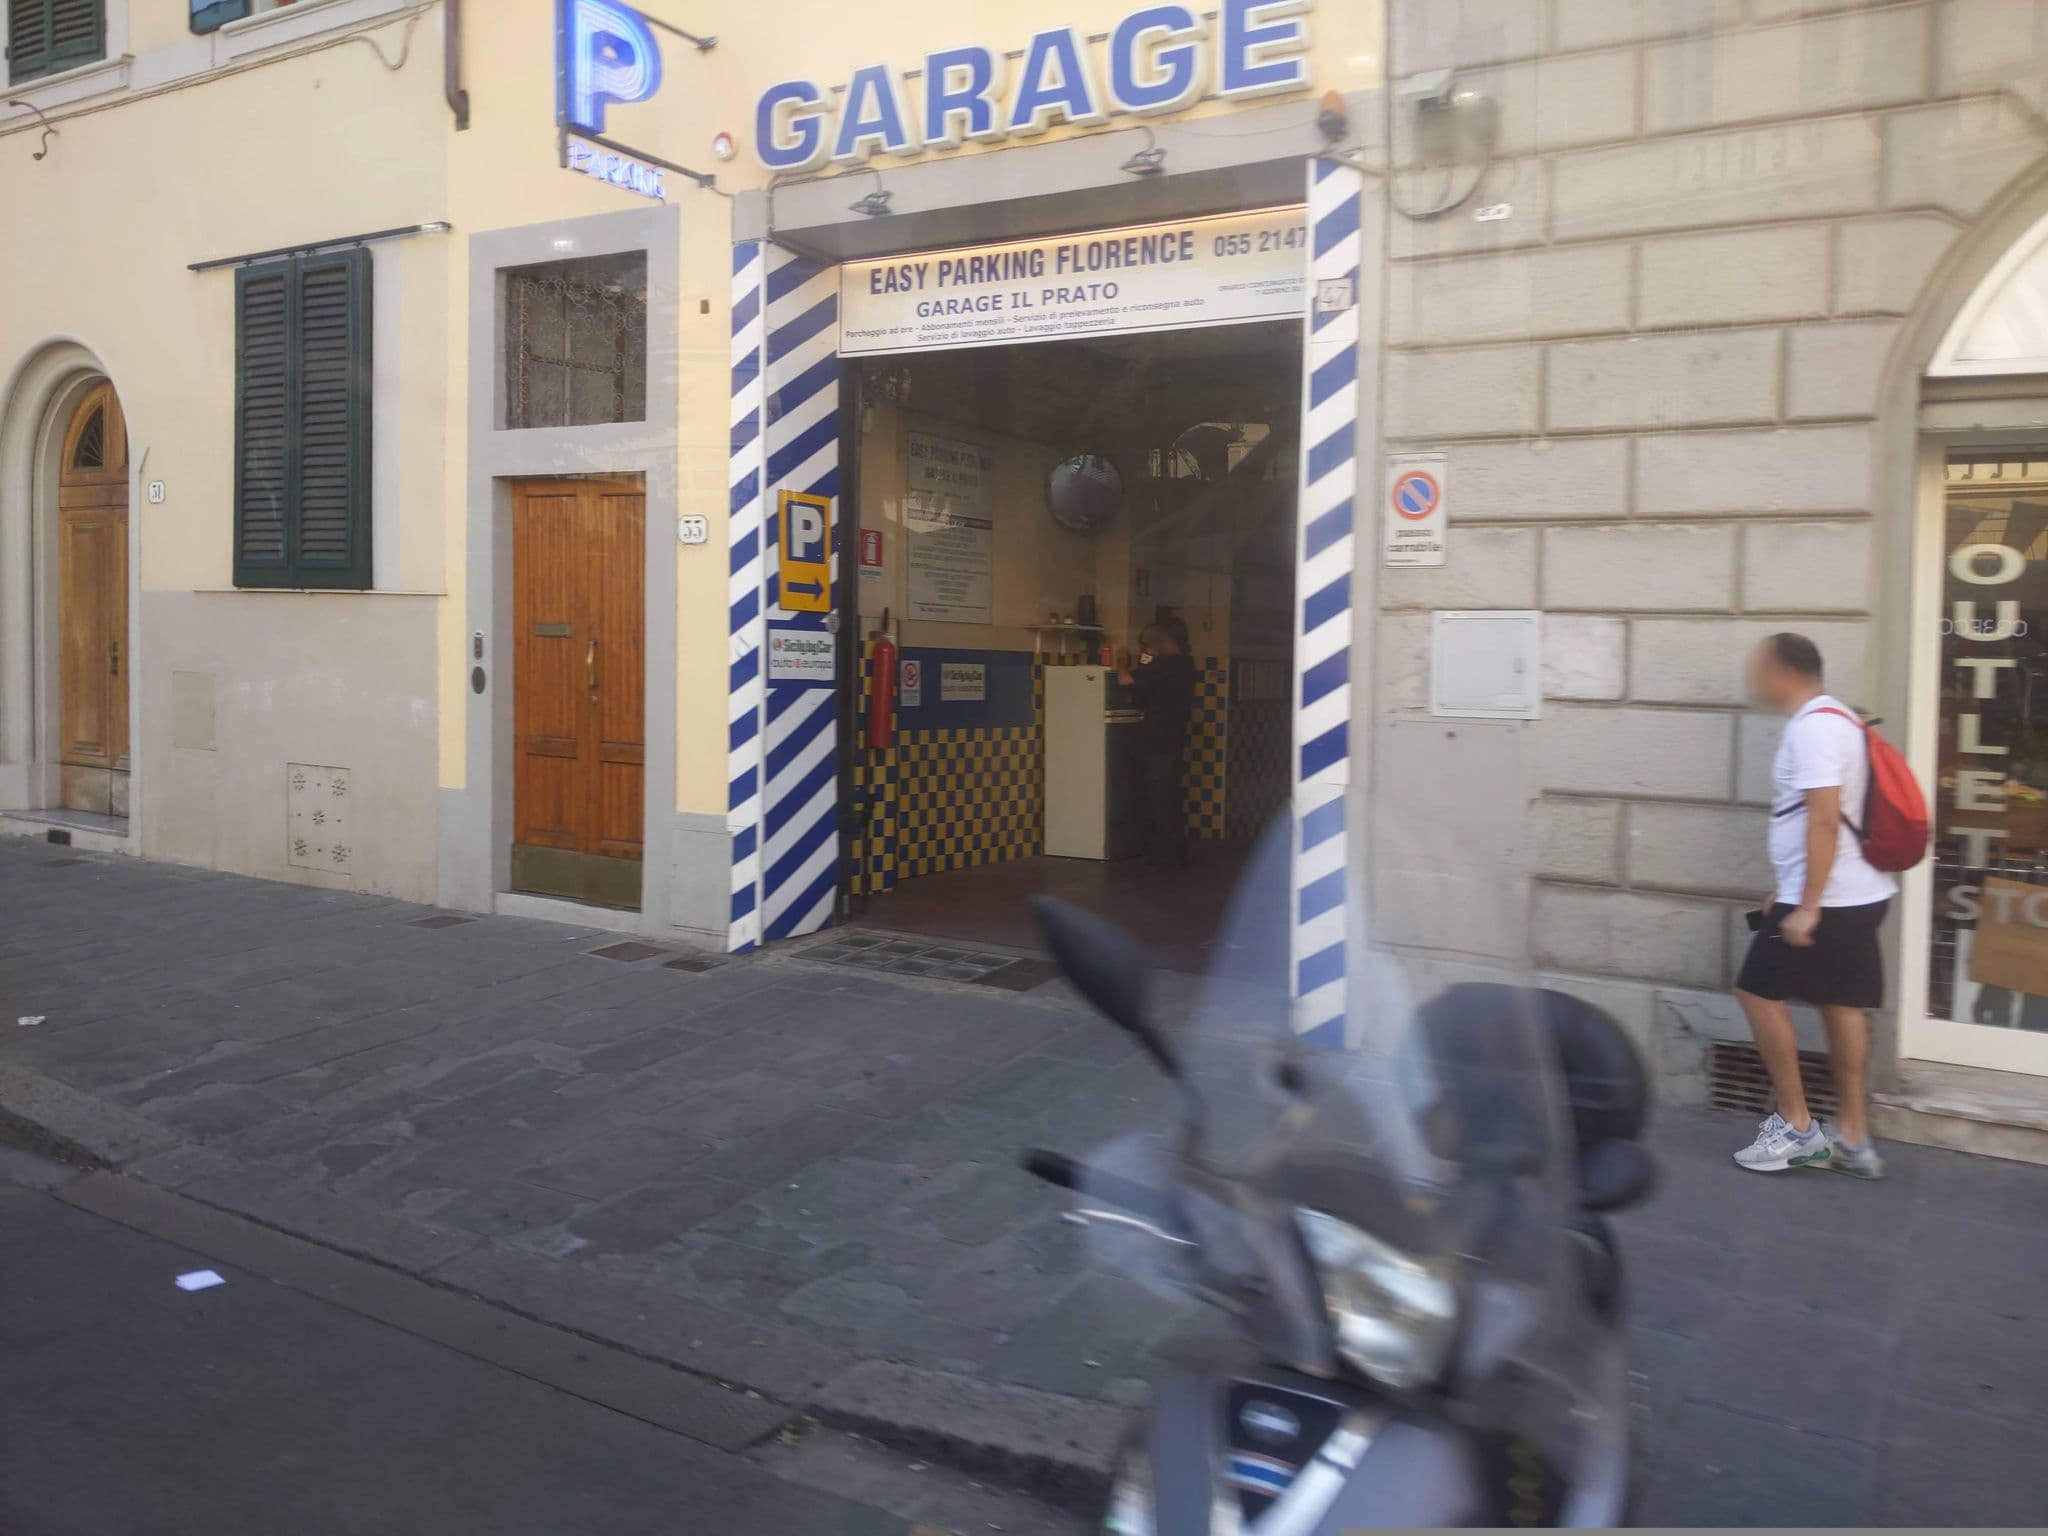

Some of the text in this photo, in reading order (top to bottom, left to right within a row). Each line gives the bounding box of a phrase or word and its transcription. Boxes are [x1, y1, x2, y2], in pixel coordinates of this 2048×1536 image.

[556, 0, 663, 136] P
[755, 0, 1308, 170] GARAGE
[568, 142, 665, 199] PARKING
[870, 230, 1195, 295] EASY PARKING FLORENCE
[1214, 233, 1251, 257] 055
[916, 281, 1120, 318] GARAGE IL PRATO
[845, 328, 887, 339] Parcheggio
[921, 318, 973, 332] Abbonamenti
[791, 503, 824, 558] P
[1948, 543, 2028, 869] OUTLET
